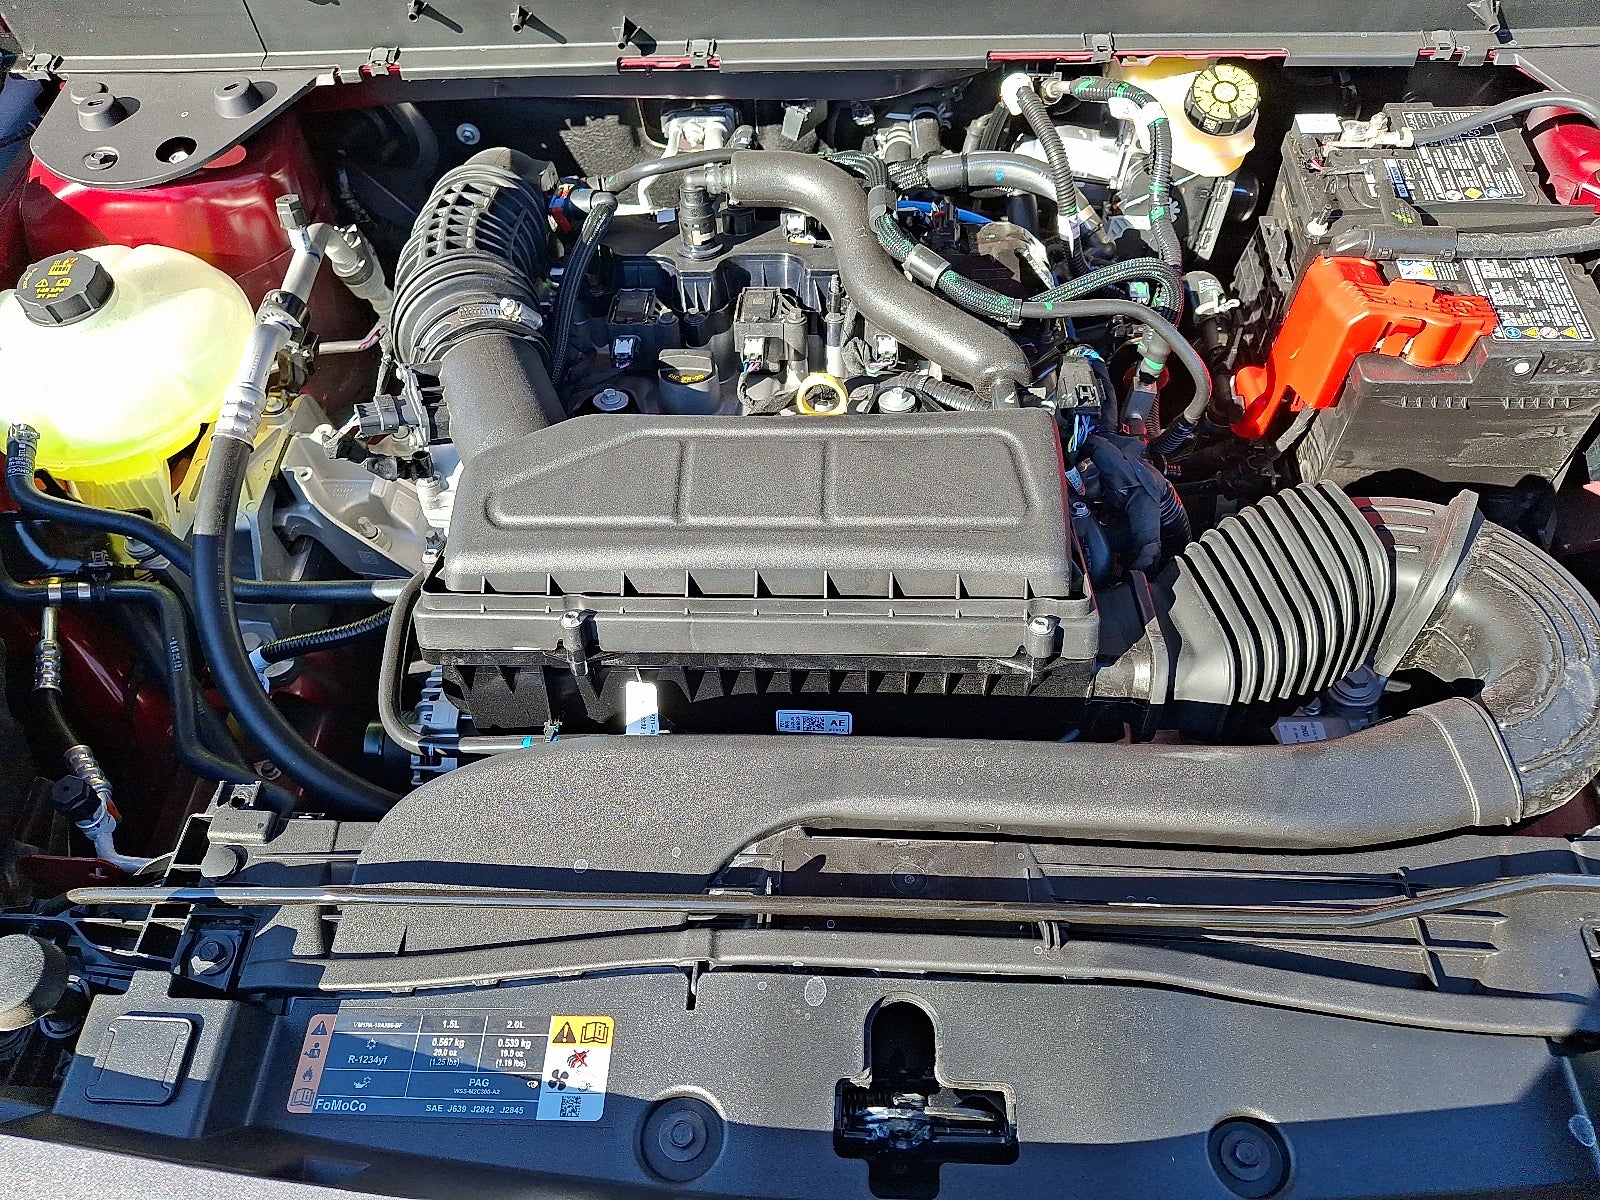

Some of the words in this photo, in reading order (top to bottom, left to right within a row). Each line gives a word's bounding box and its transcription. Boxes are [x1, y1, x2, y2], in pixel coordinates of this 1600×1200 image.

[829, 719, 846, 727] AE
[442, 1020, 460, 1029] 1.5L
[507, 1020, 526, 1030] 2.0L
[455, 1038, 466, 1049] kg
[498, 1038, 520, 1048] 0.539
[521, 1039, 532, 1050] kg
[433, 1049, 448, 1057] 20.0
[347, 1054, 389, 1065] R-1234yf
[429, 1058, 447, 1067] (1.25
[447, 1058, 460, 1067] lbs)
[513, 1059, 527, 1068] lbs)
[468, 1078, 490, 1087] PAG
[314, 1098, 367, 1112] FoMoCo
[425, 1104, 444, 1112] SAE
[446, 1105, 467, 1113] J639
[470, 1106, 495, 1114] J2842
[500, 1106, 524, 1115] J2845
